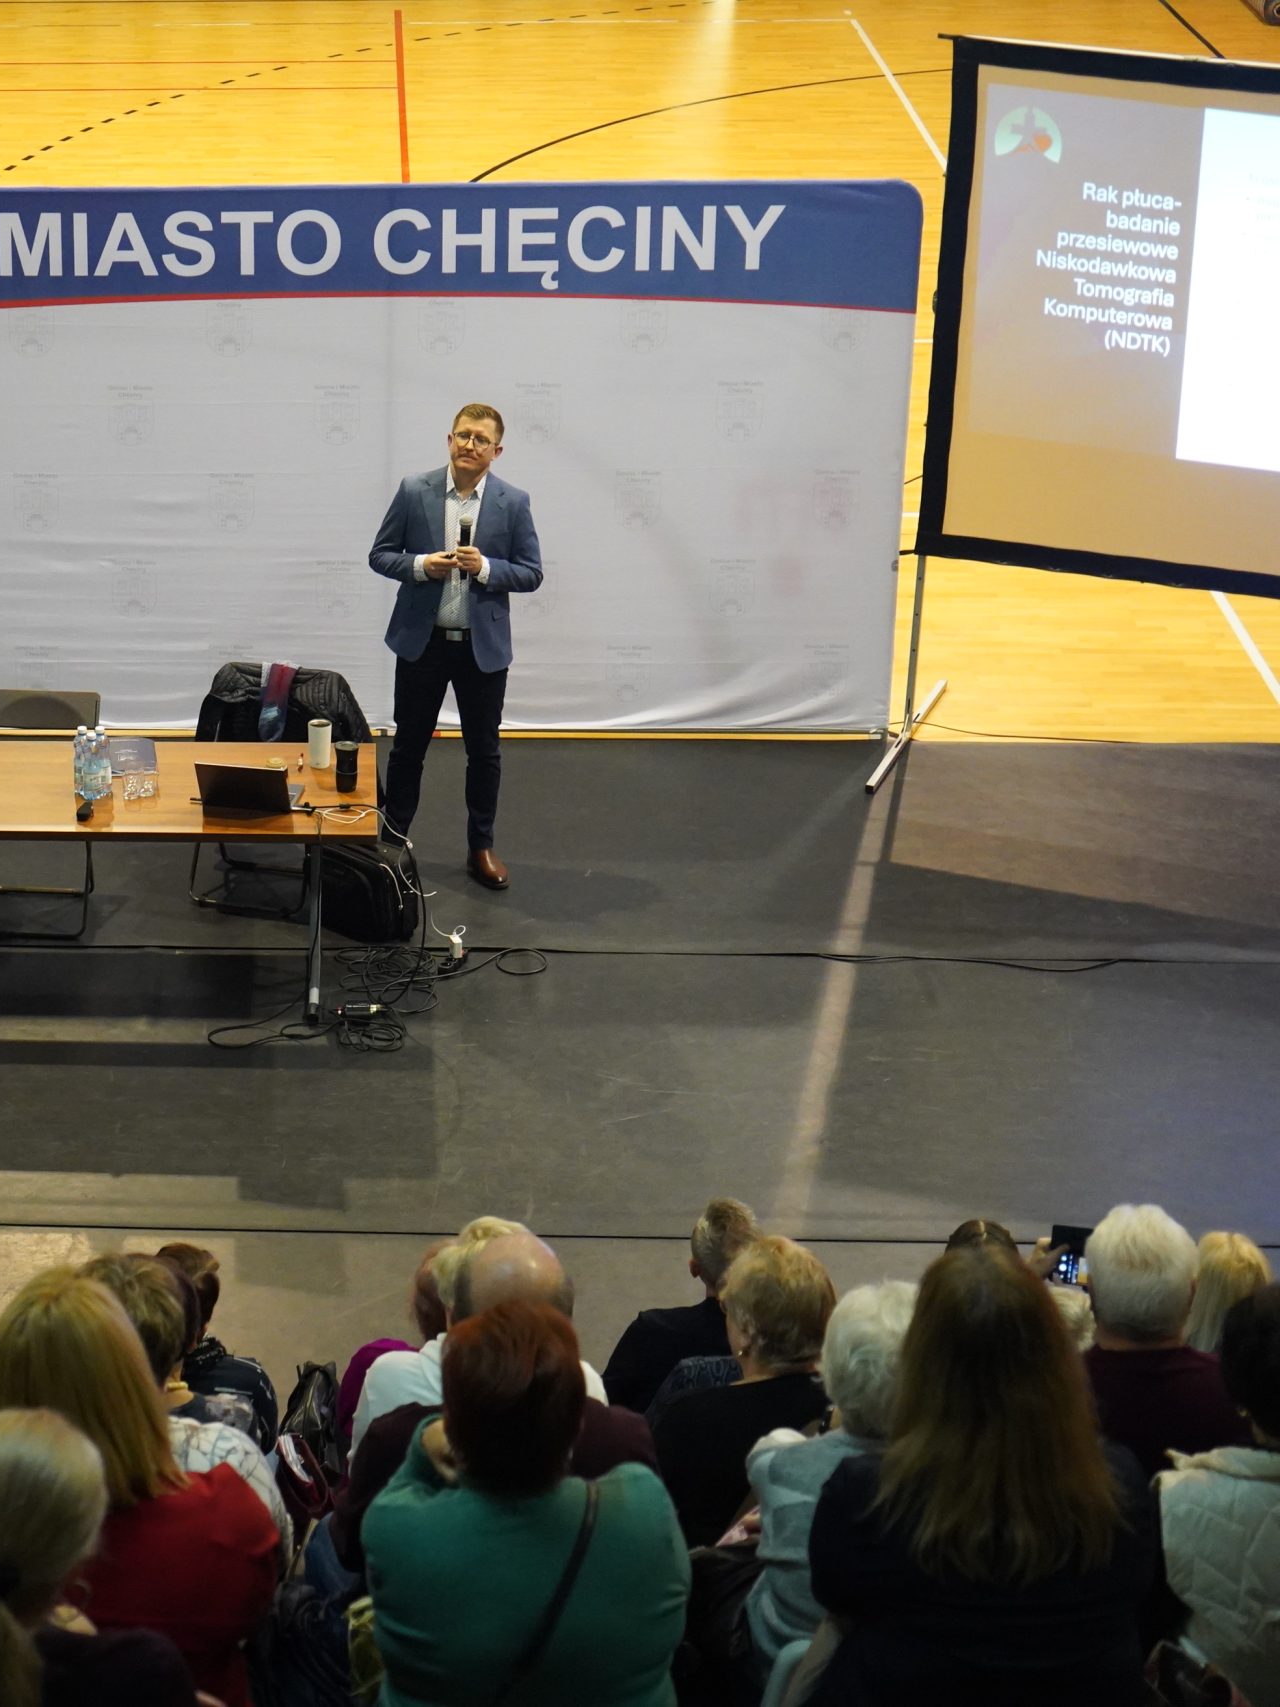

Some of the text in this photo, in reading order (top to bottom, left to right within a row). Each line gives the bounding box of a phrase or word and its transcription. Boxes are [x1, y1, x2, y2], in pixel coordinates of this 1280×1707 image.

[1082, 181, 1182, 211] Rak płuca-
[1106, 209, 1181, 236] badanie
[373, 205, 786, 290] CHĘCINY
[1056, 231, 1179, 261] przesiewowe
[1036, 249, 1177, 284] Niskodawkowa
[1073, 277, 1175, 308] Tomografia
[1043, 297, 1173, 331] Komputerowa
[1104, 329, 1171, 358] (NDTK)
